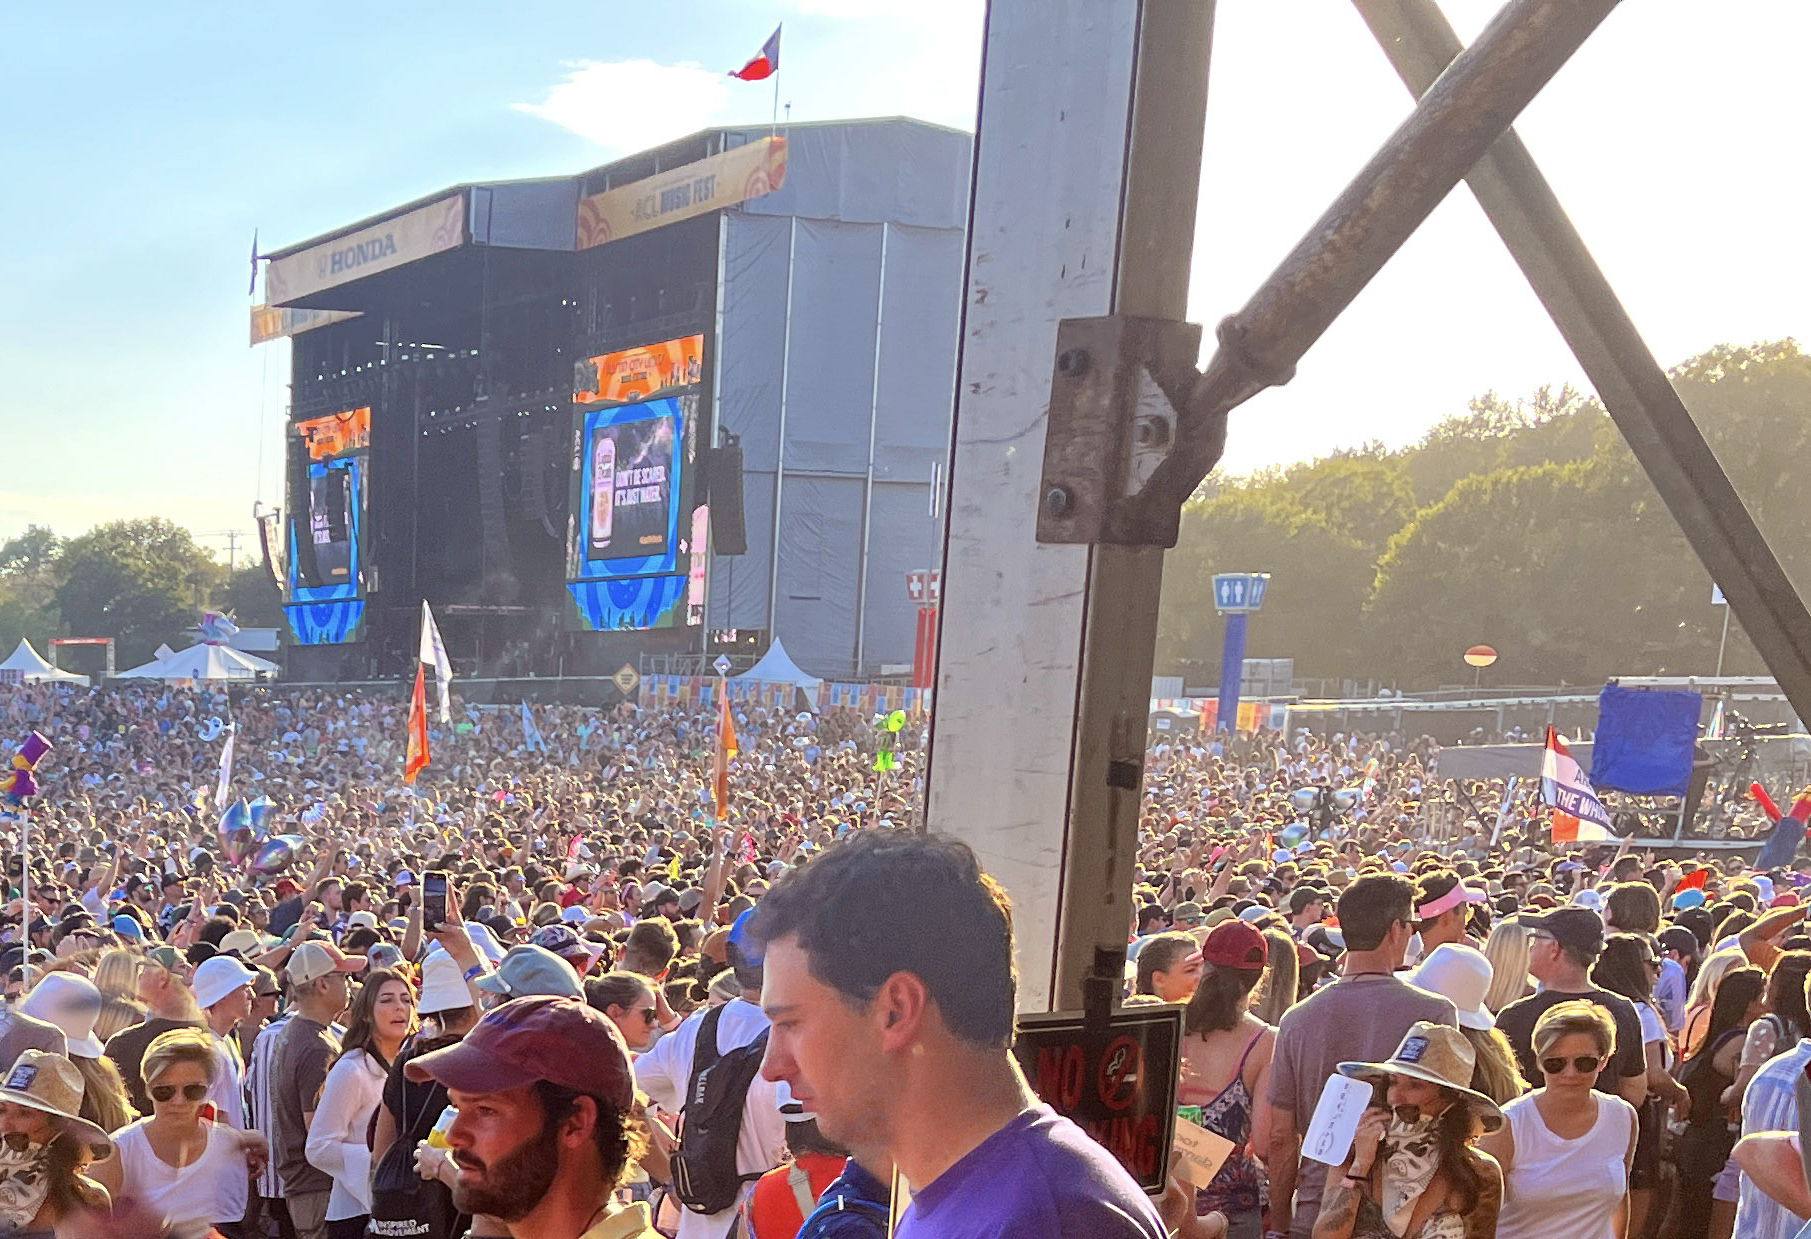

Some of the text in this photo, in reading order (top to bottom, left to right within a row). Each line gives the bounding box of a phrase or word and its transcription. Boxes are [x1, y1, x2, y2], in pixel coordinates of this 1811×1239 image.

[330, 234, 398, 274] HONDA
[1557, 787, 1579, 811] THE
[1037, 1043, 1086, 1111] NO
